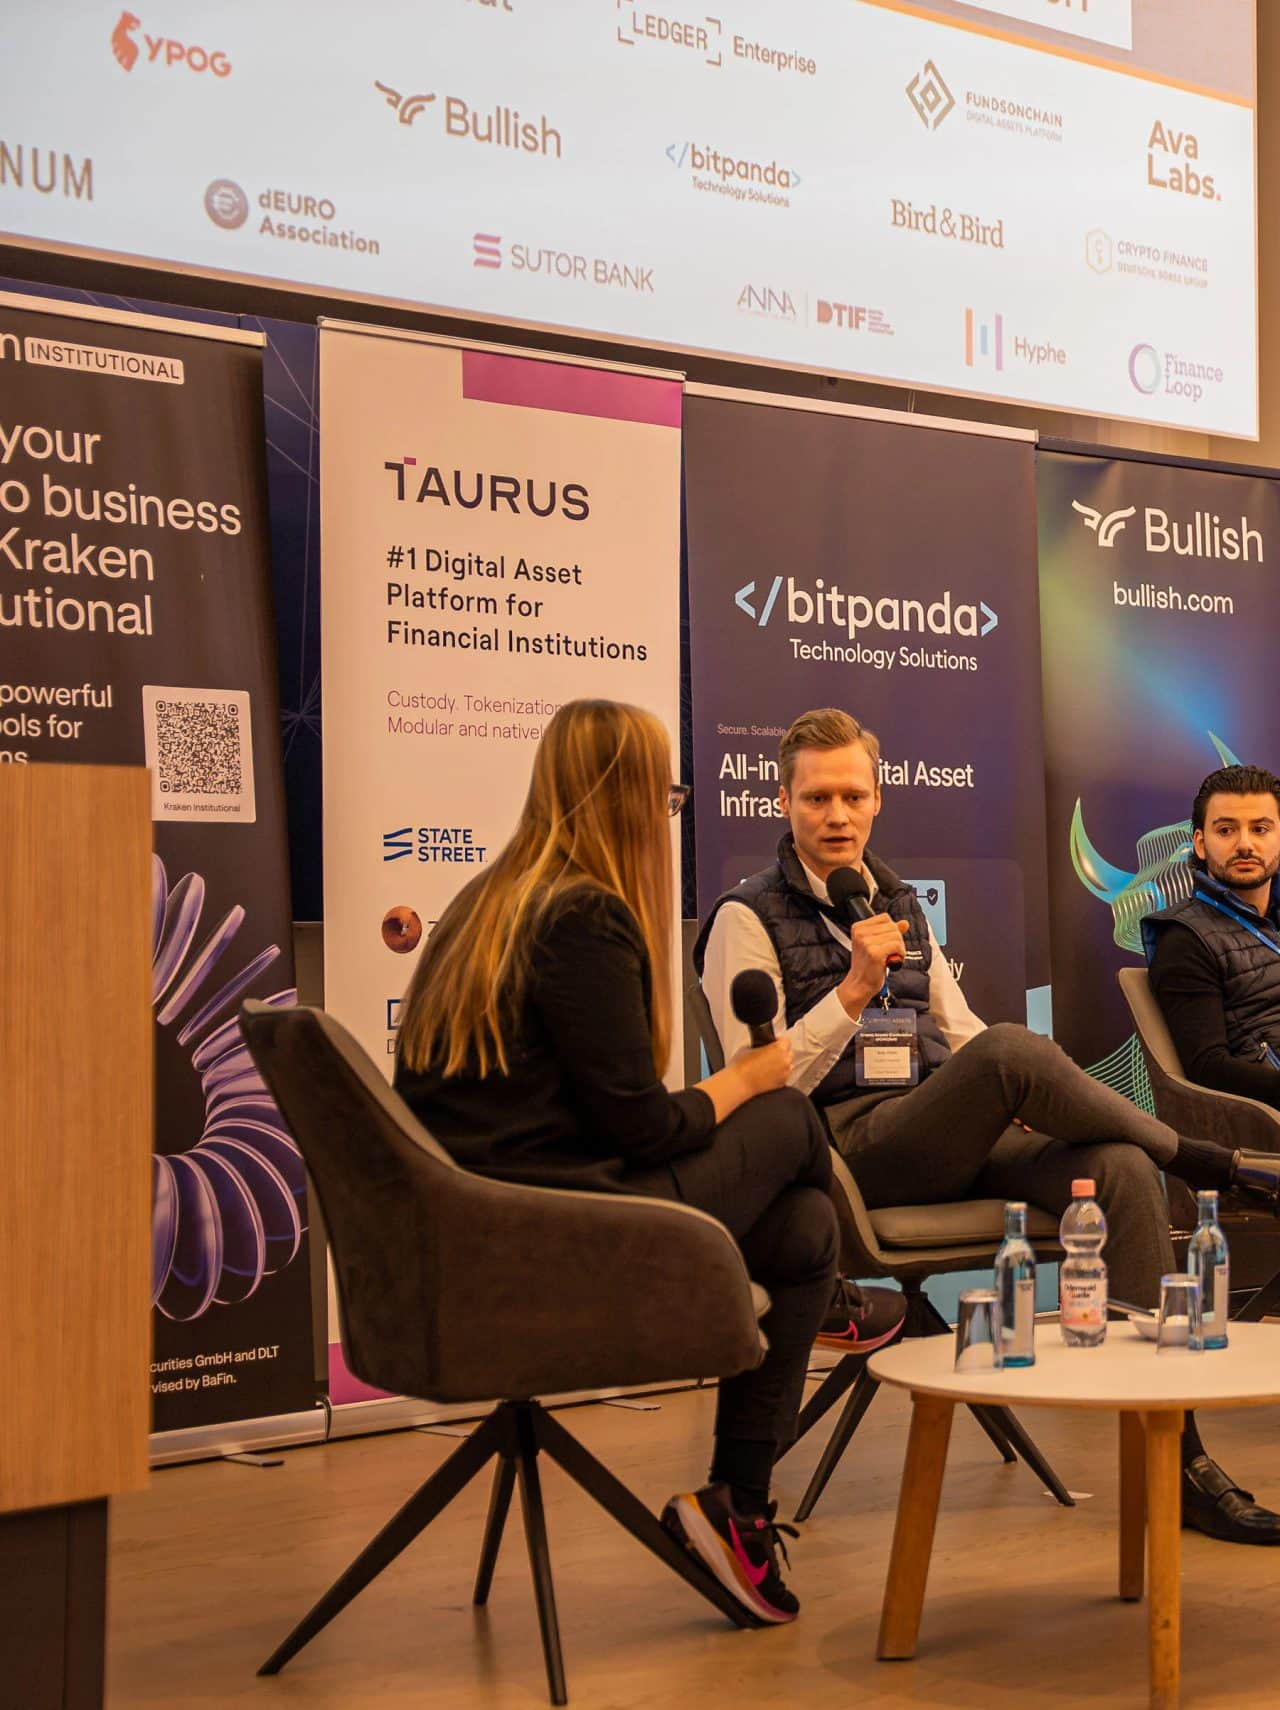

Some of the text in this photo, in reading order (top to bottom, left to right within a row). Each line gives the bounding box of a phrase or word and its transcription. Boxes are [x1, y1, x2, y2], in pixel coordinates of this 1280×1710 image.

[144, 34, 232, 78] YPOG
[632, 11, 817, 75] LEDGER Enterprise
[445, 96, 562, 158] Bullish
[966, 91, 1063, 128] FUNDSONCHAIN
[1148, 119, 1199, 160] Ava
[691, 175, 747, 202] Technology
[1146, 153, 1222, 202] Labs.
[258, 190, 336, 221] dEURO
[891, 198, 937, 234] Bird
[959, 213, 1005, 249] Bird
[258, 215, 381, 256] Association
[1117, 240, 1161, 263] CRYPTO
[510, 244, 655, 294] SUTOR BANK
[737, 283, 797, 315] ANNA
[816, 299, 867, 330] DTIF
[30, 341, 181, 381] INSTITUTIONAL
[1014, 335, 1067, 367] Hyphe
[1164, 351, 1224, 383] Finance
[1165, 373, 1203, 402] Loop
[0, 425, 101, 465] your
[43, 473, 242, 536] business
[384, 457, 590, 521] TAURUS
[1144, 507, 1264, 563] Bullish
[0, 527, 155, 582] Kraken
[386, 545, 583, 586] #1 Digital Asset
[387, 582, 544, 618] Platform for
[1113, 580, 1234, 615] bullish.com
[387, 620, 648, 662] Financial Institutions
[789, 638, 978, 672] Technology Solutions
[47, 714, 83, 740] for
[387, 716, 545, 741] Modular and nativel
[719, 752, 975, 788] All-in ital Asset
[163, 802, 241, 813] Kraken Institutional
[719, 789, 784, 818] Infras
[417, 828, 473, 844] STATE
[417, 846, 487, 863] STREET
[194, 1351, 233, 1368] GmbH
[234, 1348, 256, 1362] and
[257, 1345, 280, 1360] DLT
[185, 1377, 201, 1391] by
[202, 1372, 237, 1388] BaFin.
